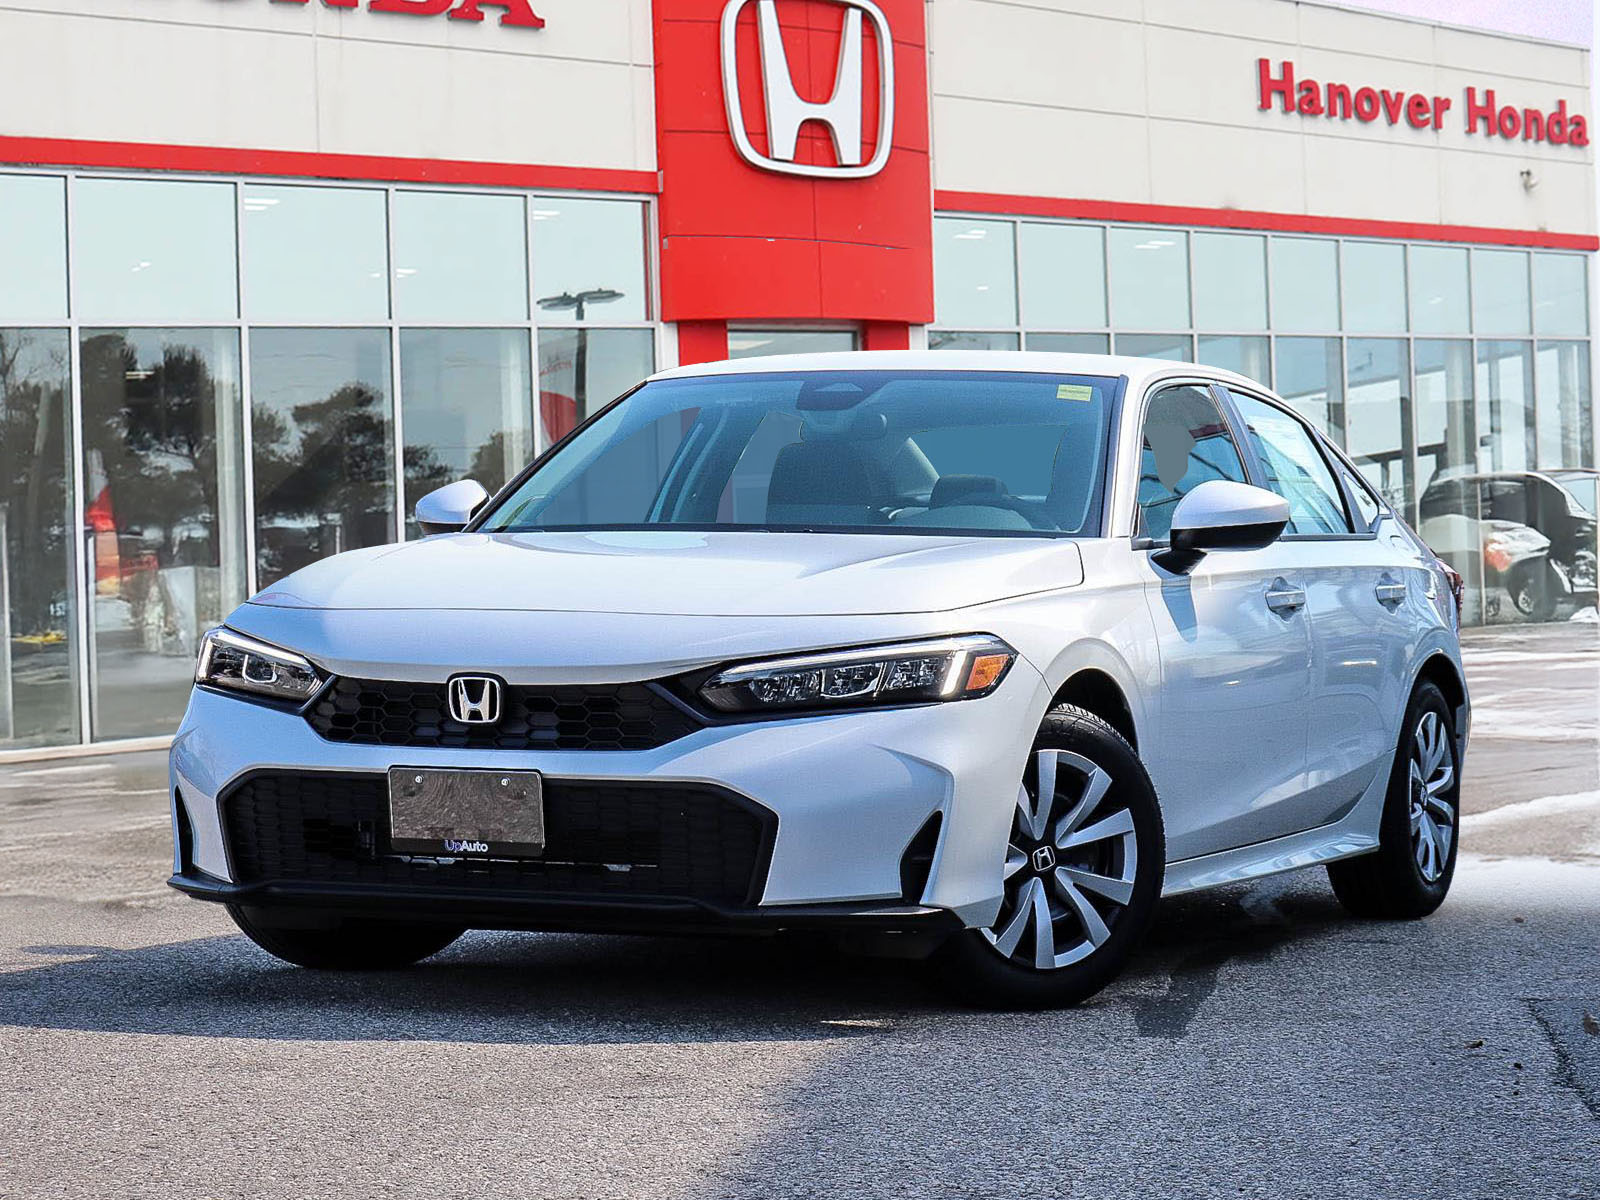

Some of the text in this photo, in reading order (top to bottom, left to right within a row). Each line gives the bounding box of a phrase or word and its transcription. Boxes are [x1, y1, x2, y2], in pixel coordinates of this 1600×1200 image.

[1257, 58, 1589, 147] Hanover Honda
[444, 839, 489, 853] UpAuto
